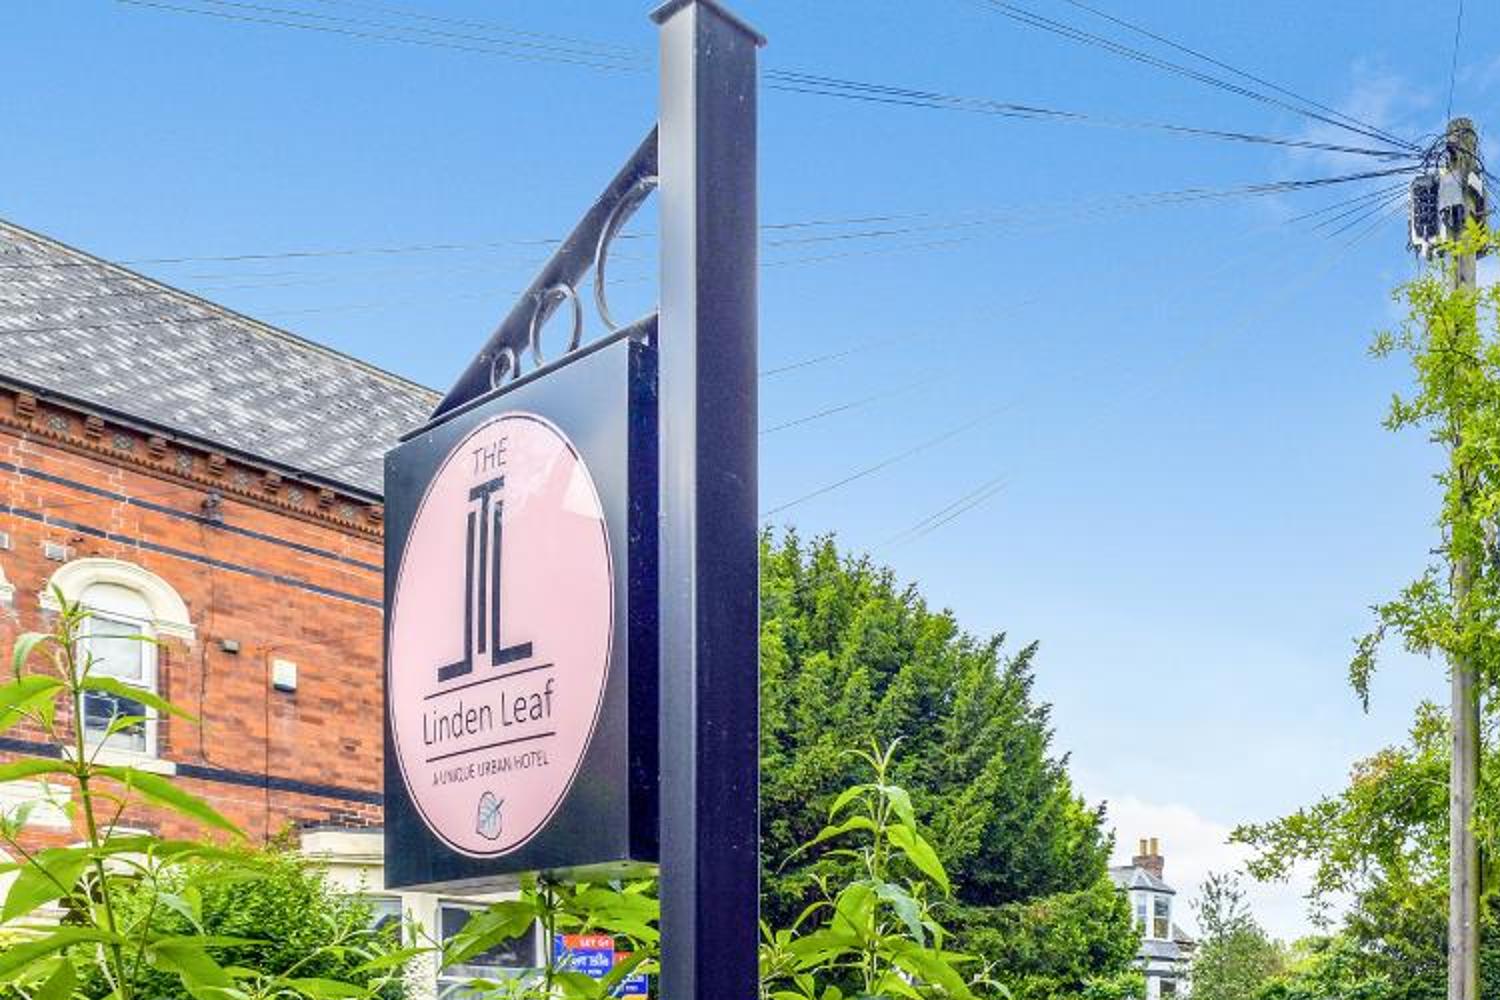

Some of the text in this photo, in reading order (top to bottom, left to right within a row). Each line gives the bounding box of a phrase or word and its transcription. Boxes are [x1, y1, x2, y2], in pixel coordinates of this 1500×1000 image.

[472, 436, 508, 474] THE
[423, 678, 554, 745] Linden Leaf
[440, 763, 475, 784] UNIQUE
[478, 757, 512, 776] URBAN
[514, 751, 549, 768] HOTEL
